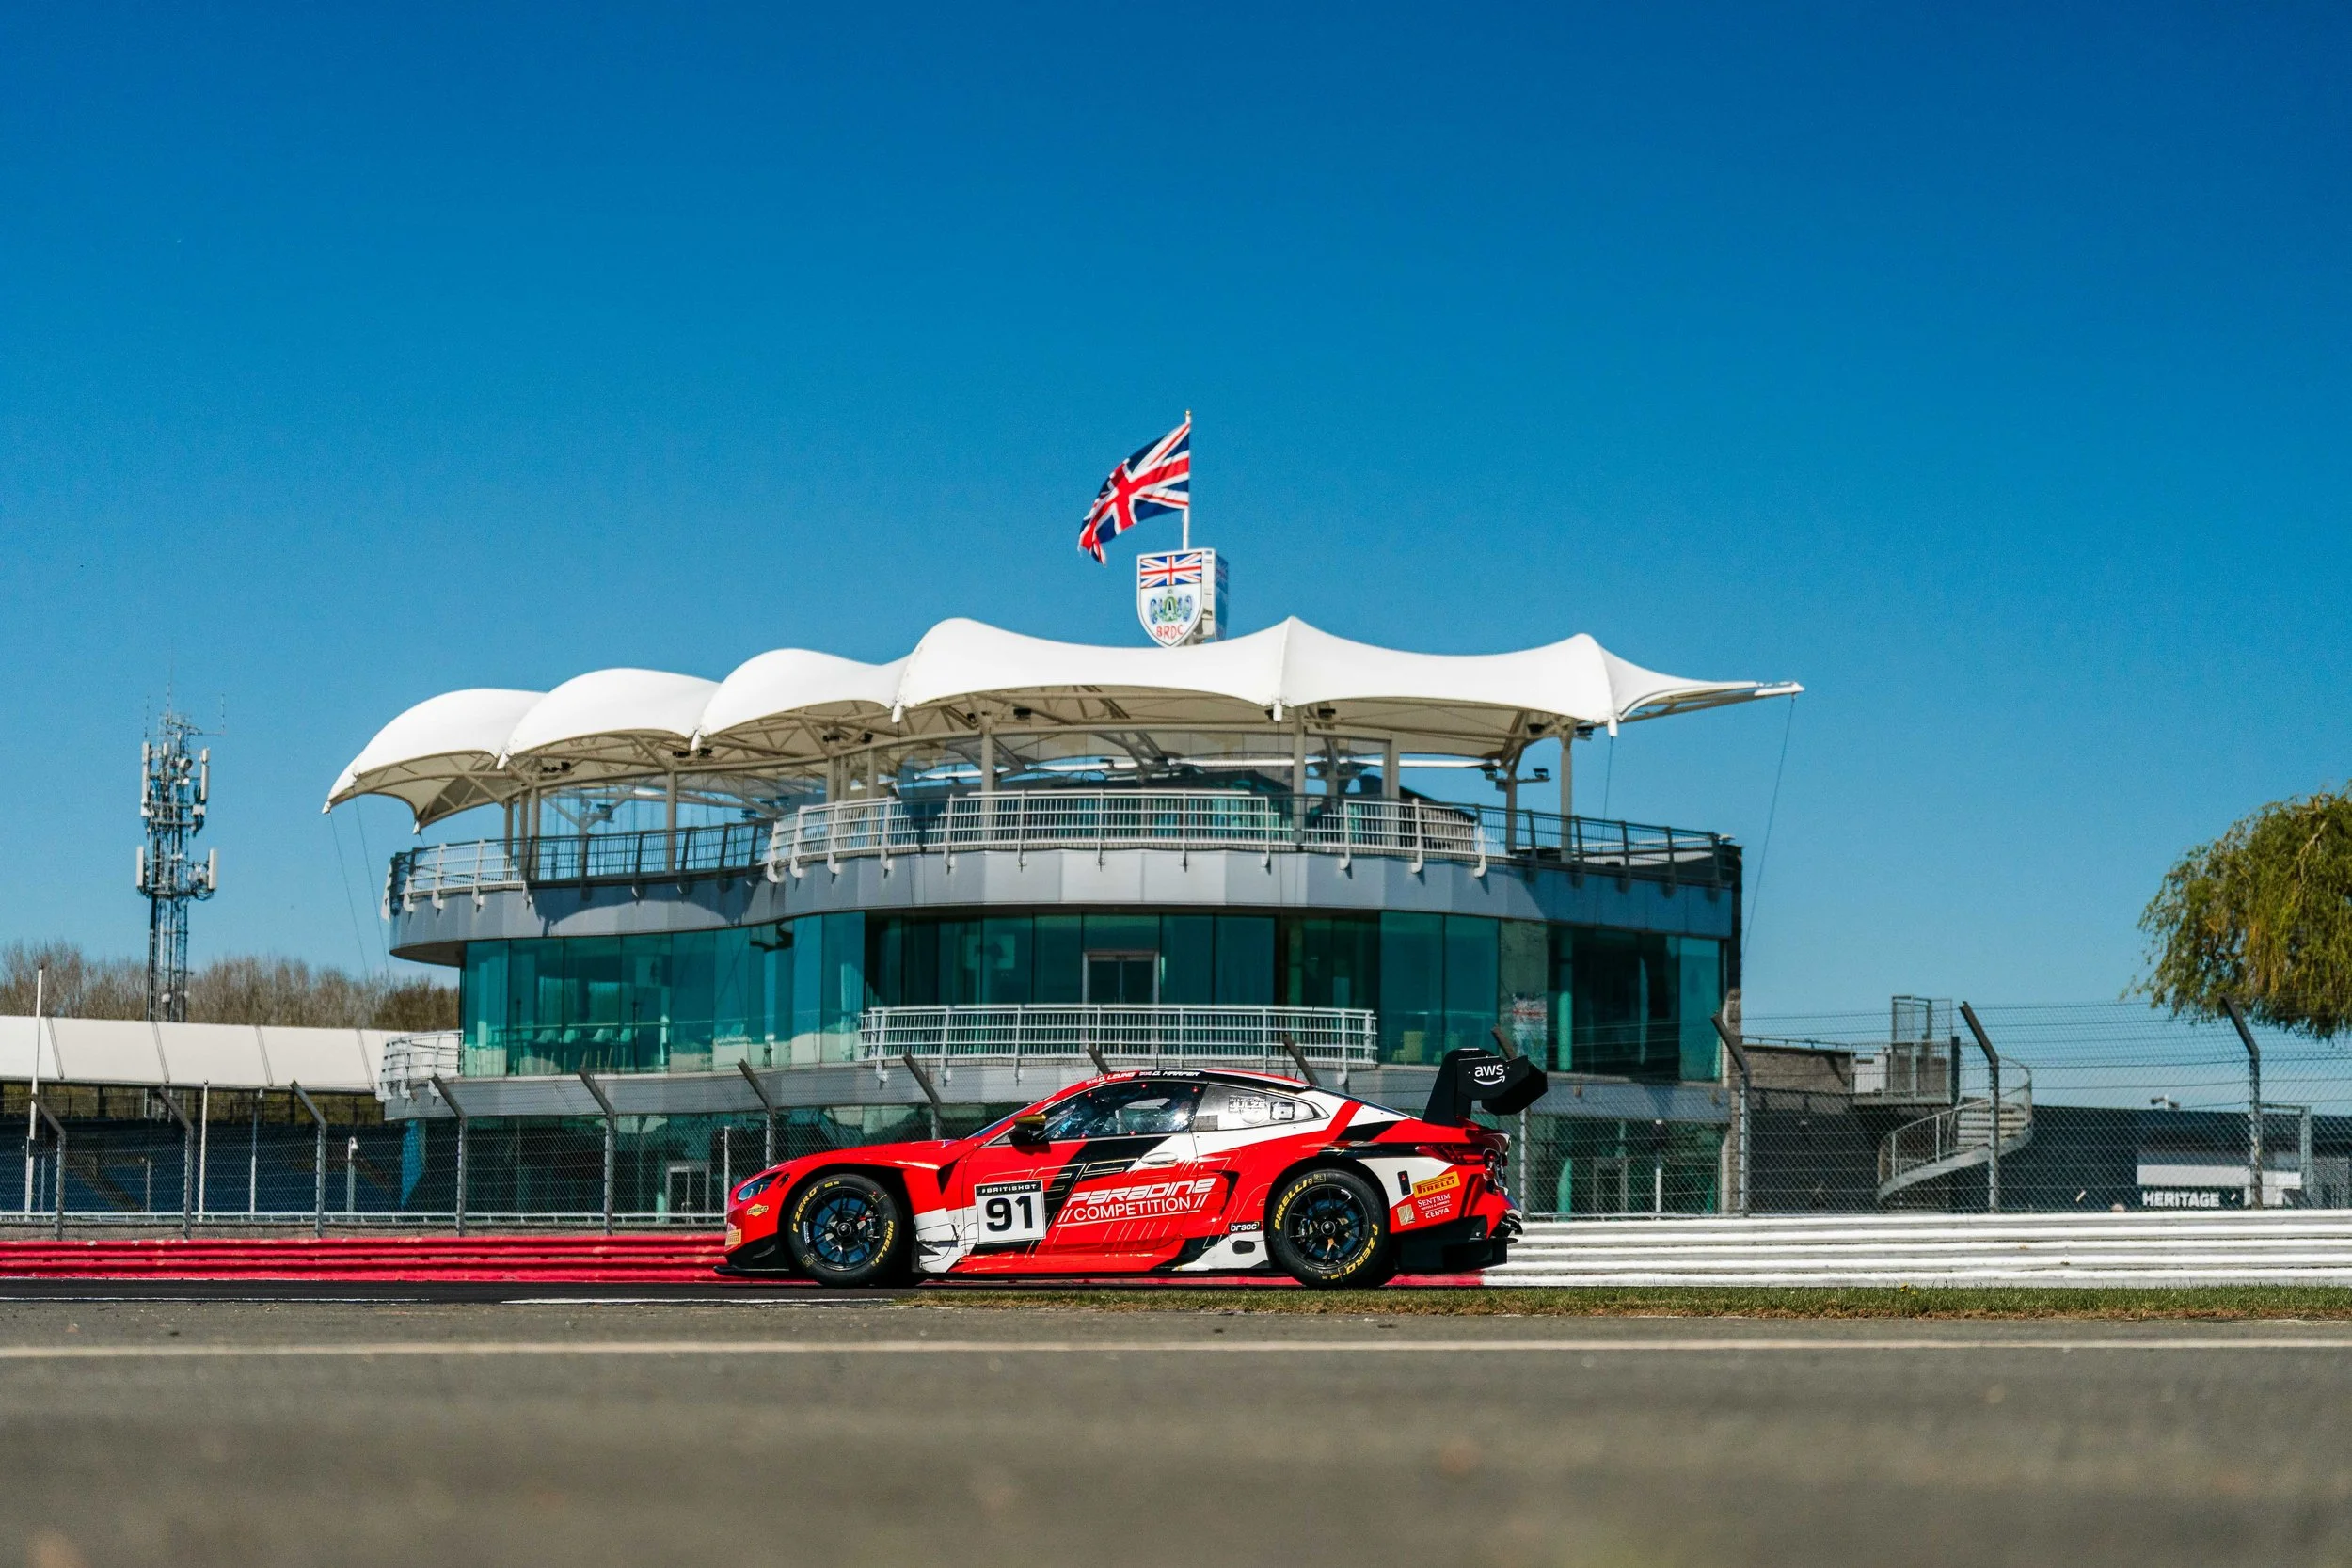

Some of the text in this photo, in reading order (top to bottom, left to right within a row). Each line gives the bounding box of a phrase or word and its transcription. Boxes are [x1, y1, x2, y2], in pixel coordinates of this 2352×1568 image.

[1156, 624, 1184, 640] BRDC
[1474, 1064, 1504, 1077] aws
[1416, 1175, 1454, 1194] PIRELLI
[1274, 1180, 1307, 1231] PIRELLI
[1417, 1193, 1451, 1207] SENTRIM
[2142, 1190, 2220, 1207] HERITAGE
[985, 1195, 1033, 1233] 91
[1230, 1223, 1257, 1231] brscc
[875, 1220, 894, 1264] PIRELLI
